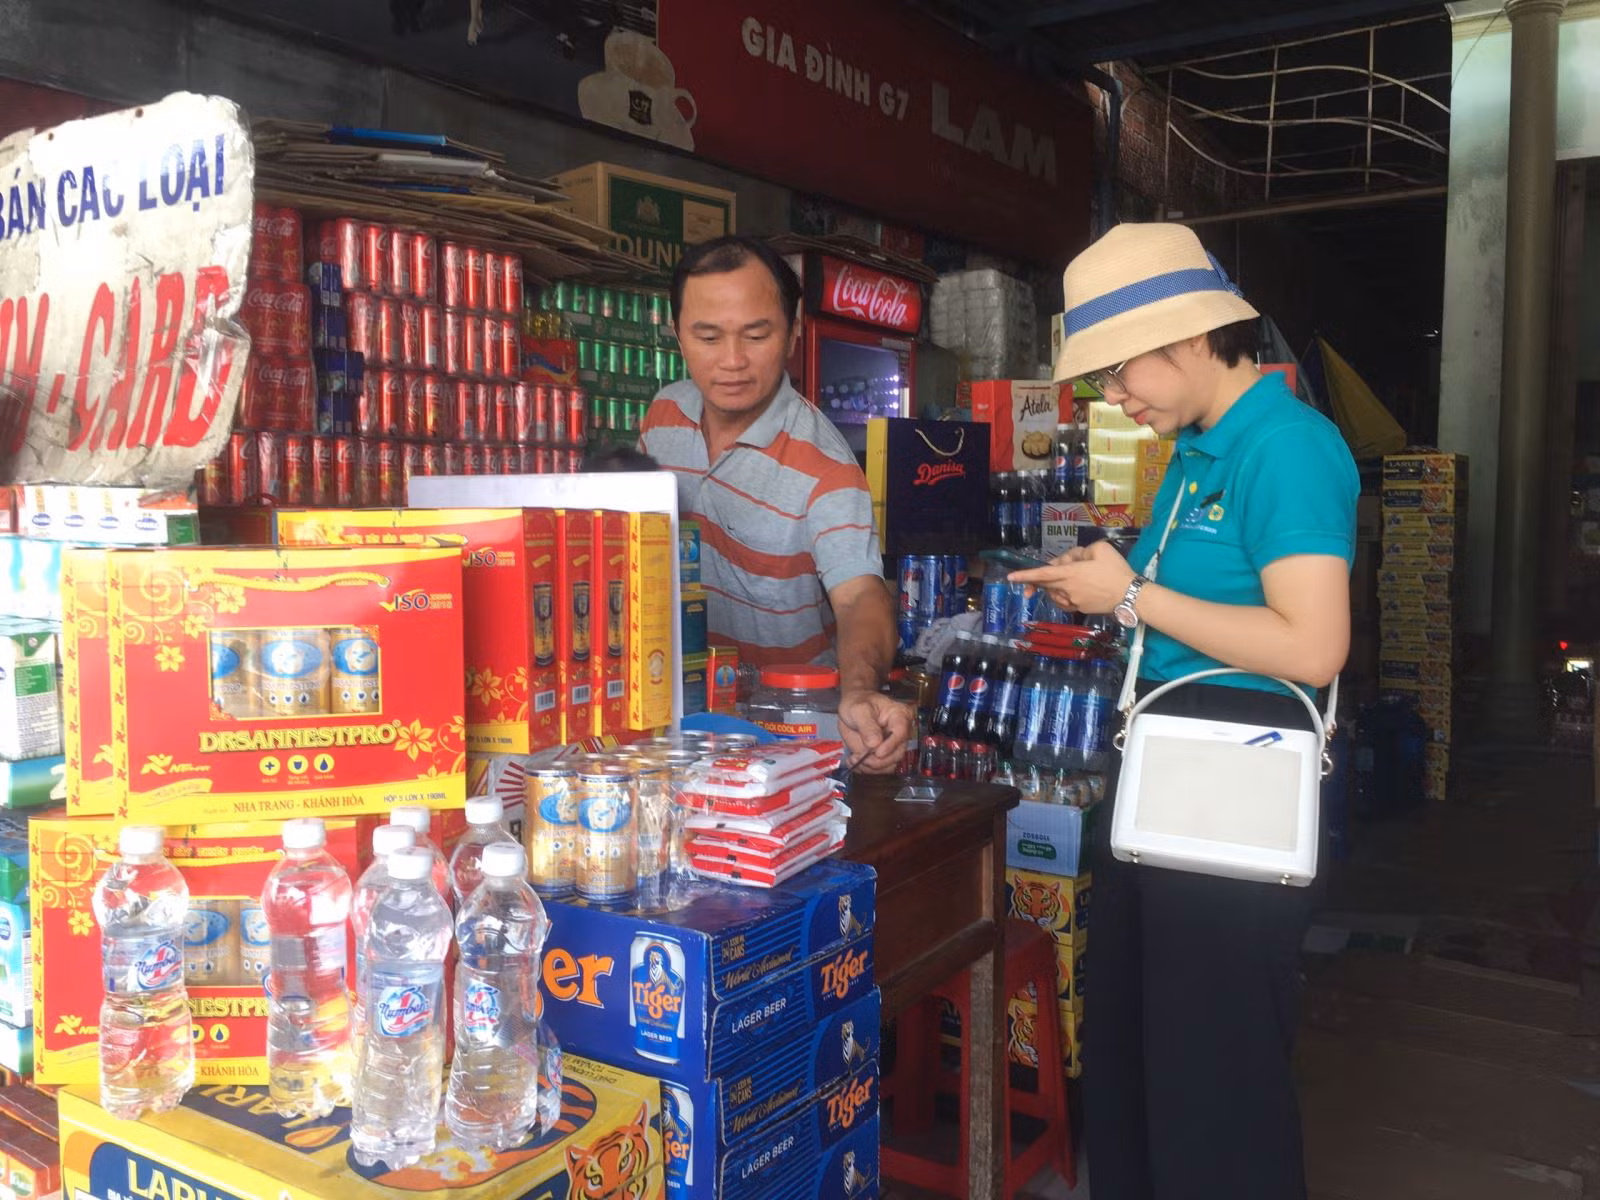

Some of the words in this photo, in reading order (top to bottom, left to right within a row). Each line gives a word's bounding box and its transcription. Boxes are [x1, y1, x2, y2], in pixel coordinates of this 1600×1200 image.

[741, 16, 799, 75] GIA
[805, 42, 871, 107] ĐÌNH
[879, 81, 910, 121] G7
[931, 80, 1058, 188] LAM
[0, 166, 46, 240] ÁN
[138, 134, 226, 213] LOẠI
[832, 264, 909, 326] Coca-Cola
[1018, 393, 1053, 423] Atela
[911, 461, 967, 487] Danisa
[1047, 524, 1064, 537] BIA
[469, 551, 497, 568] ISO
[394, 594, 429, 610] ISO
[798, 726, 813, 735] AIR
[233, 801, 258, 814] NHA
[259, 799, 295, 812] TRANG
[303, 794, 341, 810] KHÁNH
[343, 791, 365, 807] HÒA
[820, 948, 869, 1000] Tiger
[633, 981, 681, 1019] Tiger
[731, 1008, 763, 1035] LAGER
[764, 997, 787, 1018] BEER
[201, 1064, 236, 1077] KHÁNH
[238, 1063, 260, 1077] HÒA
[826, 1075, 875, 1129] Tiger
[741, 1150, 771, 1180] LAGER
[772, 1135, 796, 1159] BEER
